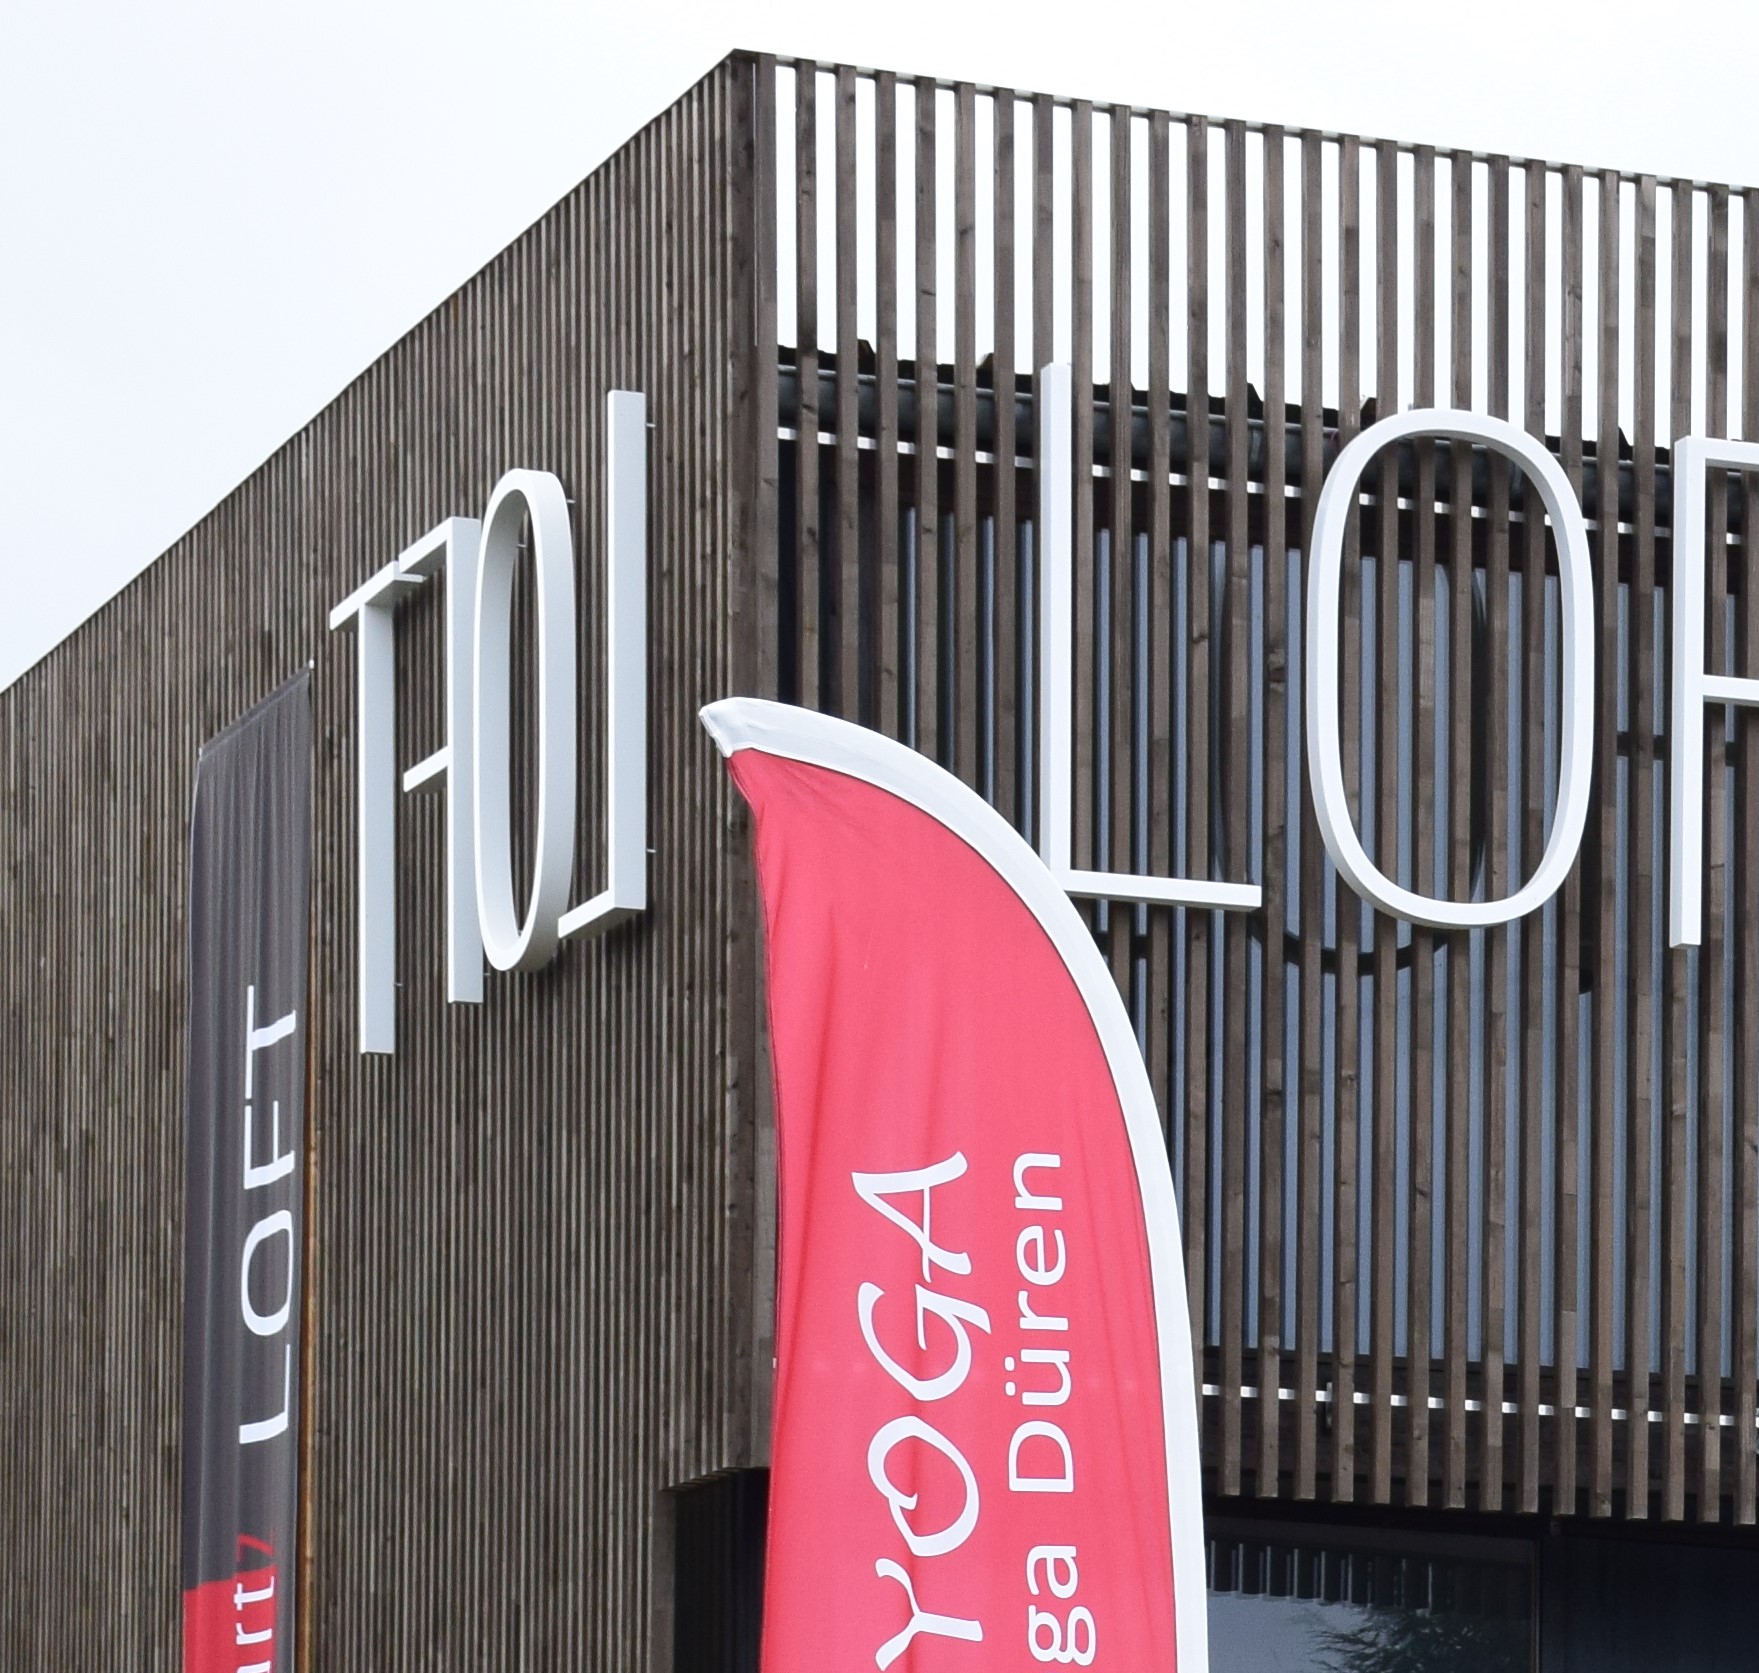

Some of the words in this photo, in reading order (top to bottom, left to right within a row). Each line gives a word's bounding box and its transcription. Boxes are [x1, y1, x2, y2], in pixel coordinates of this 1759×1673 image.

[239, 984, 297, 1445] LOFT
[851, 1151, 992, 1672] YOGA
[1004, 1152, 1080, 1493] Düren
